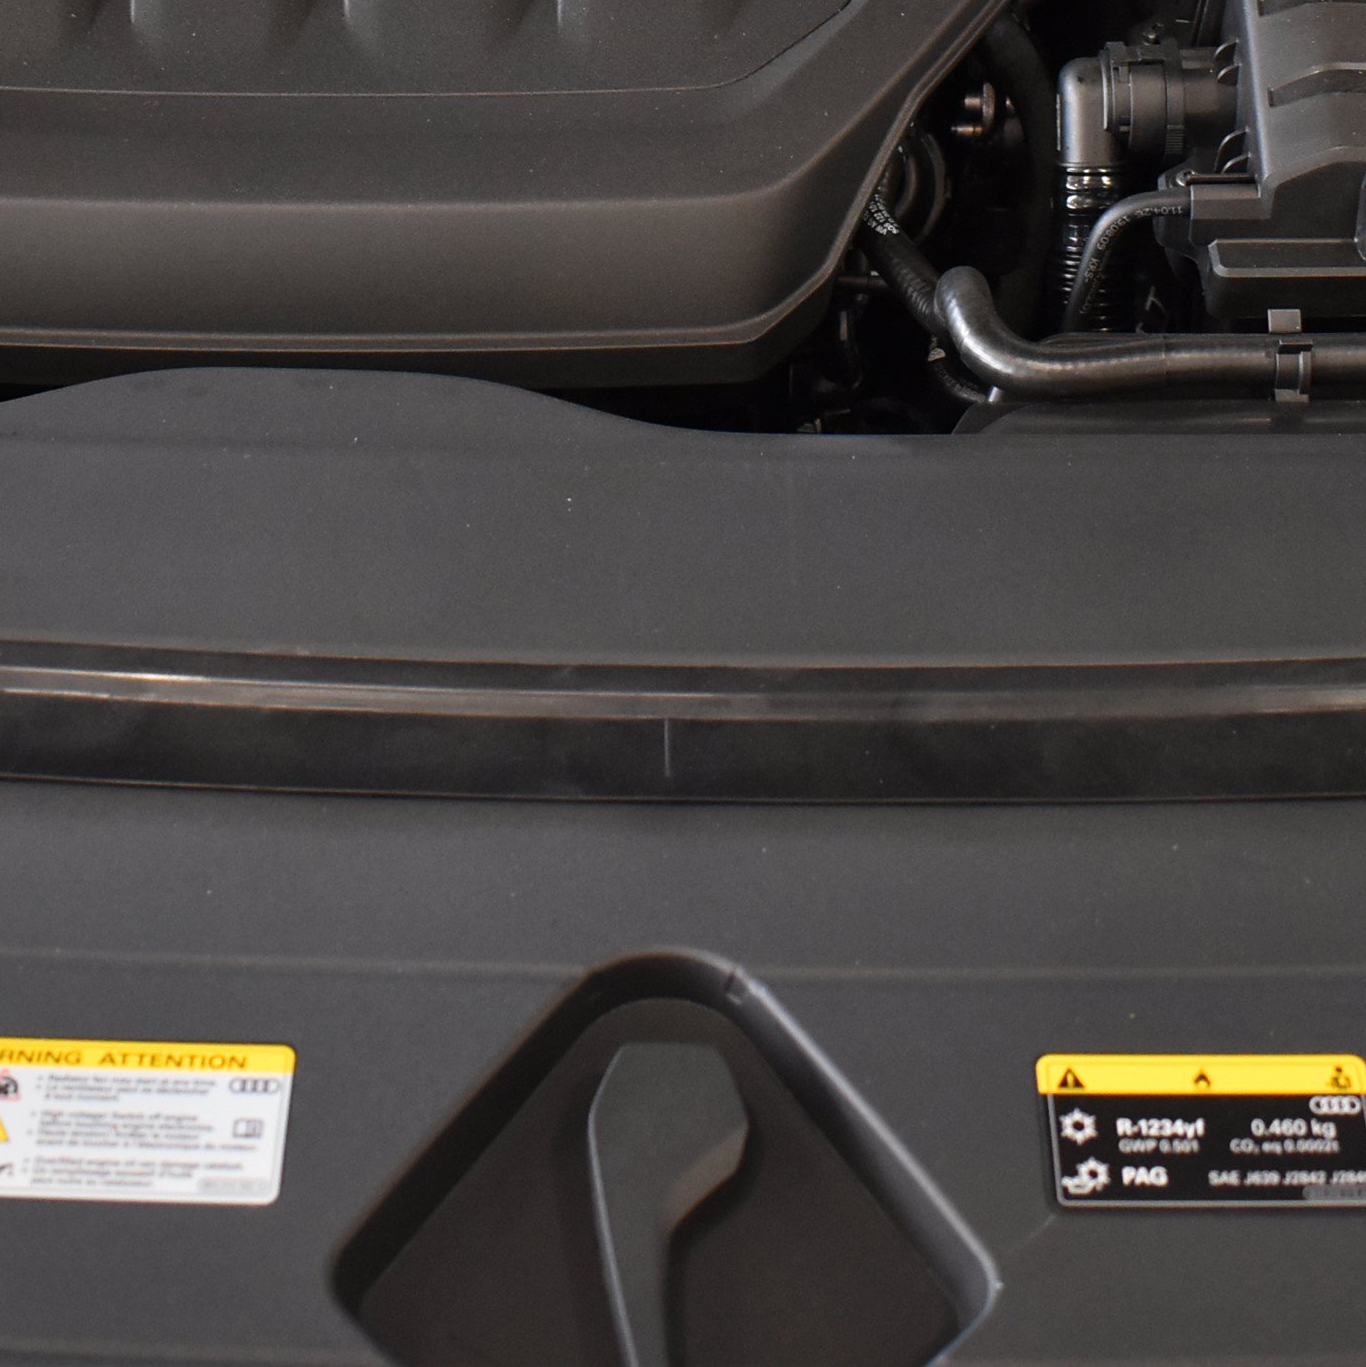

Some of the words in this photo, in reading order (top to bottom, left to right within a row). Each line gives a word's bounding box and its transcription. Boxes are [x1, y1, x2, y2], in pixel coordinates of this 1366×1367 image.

[98, 1051, 247, 1069] ATTENTION
[1116, 1118, 1205, 1139] R-1234yf
[1310, 1118, 1337, 1139] kg
[1118, 1138, 1158, 1154] GWP
[1121, 1166, 1169, 1187] PAG
[1207, 1170, 1241, 1186] SAE
